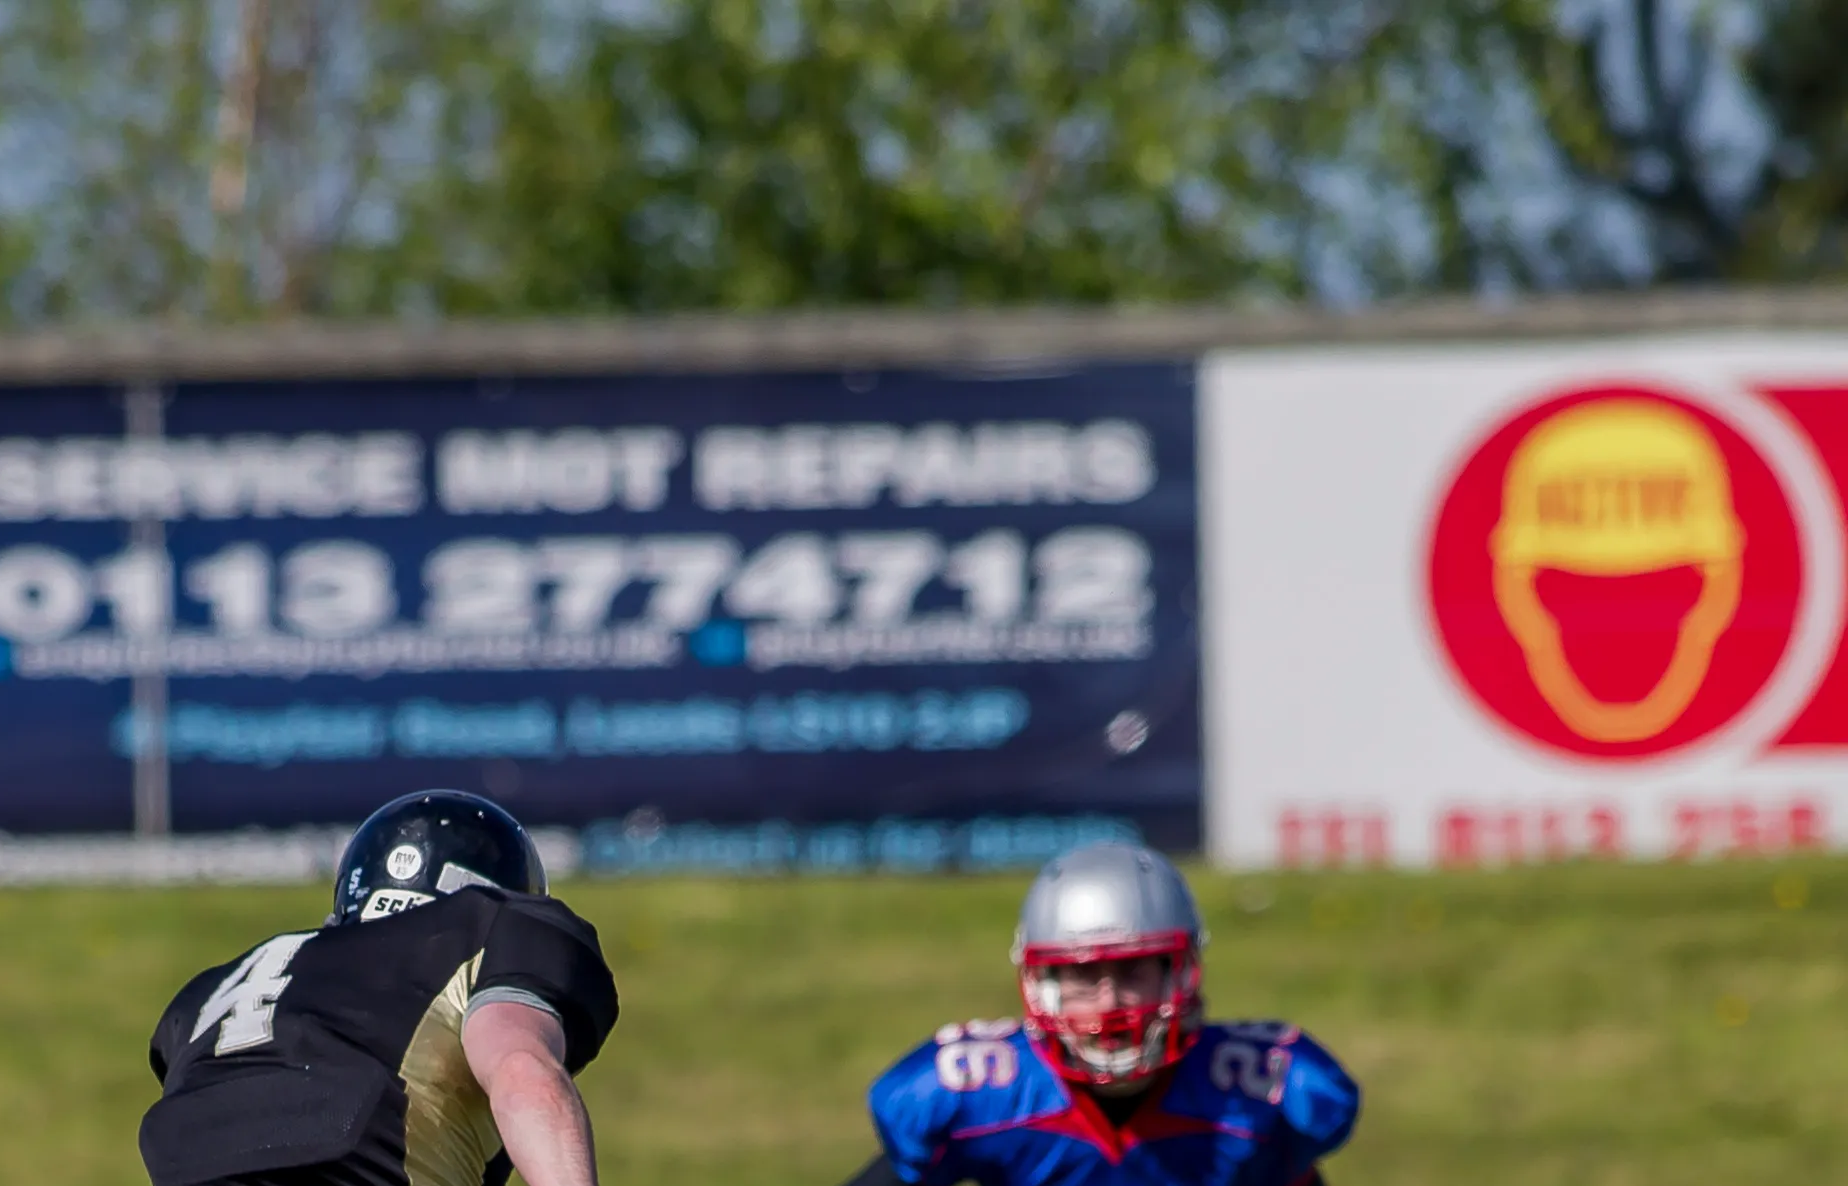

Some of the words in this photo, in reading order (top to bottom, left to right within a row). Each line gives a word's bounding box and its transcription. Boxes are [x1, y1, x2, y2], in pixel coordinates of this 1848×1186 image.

[438, 430, 680, 513] MOT
[691, 421, 1154, 510] REPAIRS
[421, 527, 1154, 629] 2774712
[190, 931, 319, 1057] 4
